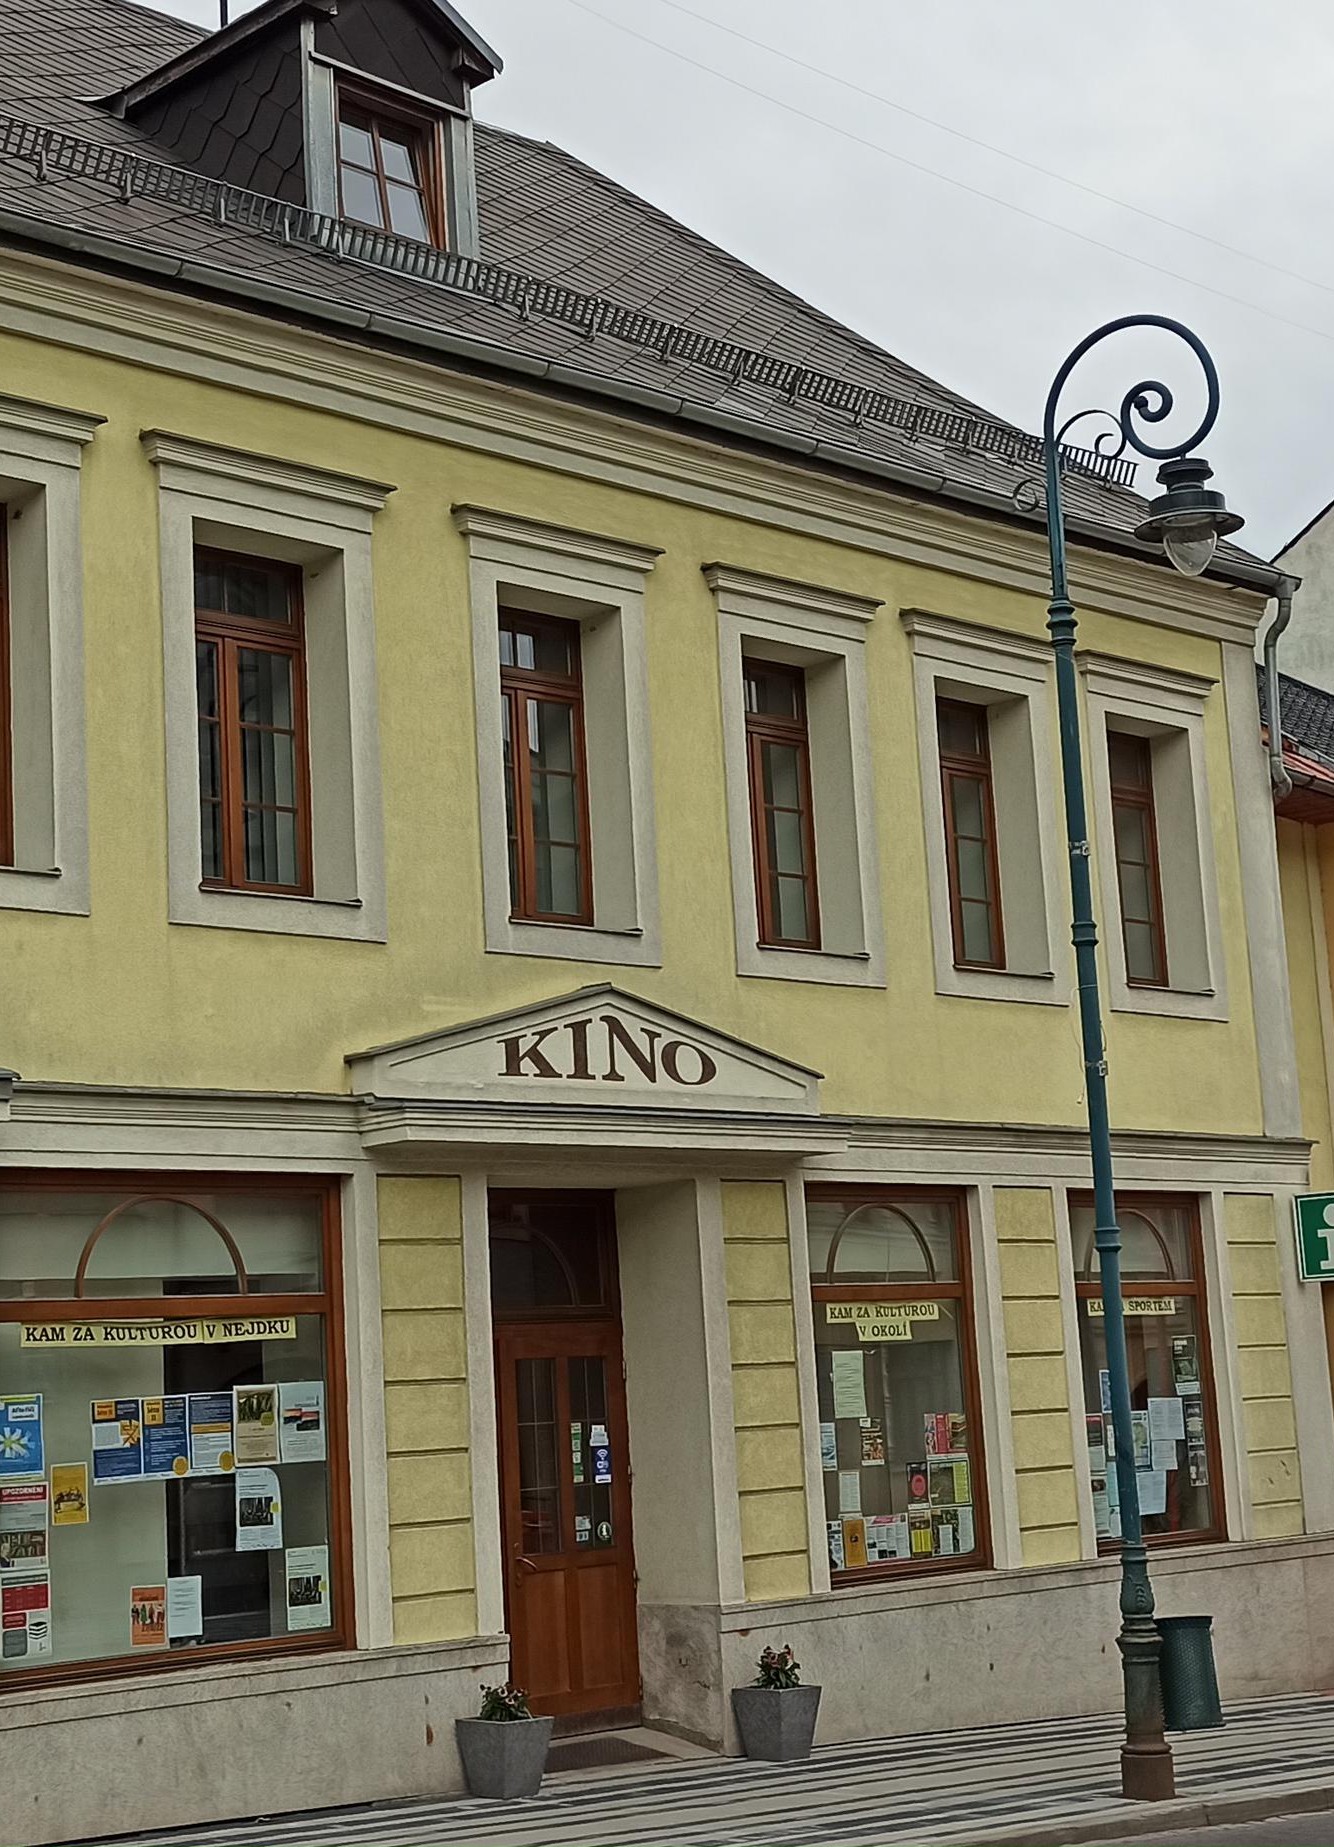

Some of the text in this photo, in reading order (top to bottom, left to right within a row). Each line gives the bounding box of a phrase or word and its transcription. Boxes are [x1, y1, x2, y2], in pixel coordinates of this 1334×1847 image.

[496, 1015, 717, 1085] KINO
[829, 1304, 935, 1319] KAM ZA KULTUROU
[1128, 1300, 1173, 1312] SPORTEM
[25, 1320, 291, 1342] KAM ZA KULTUROU V NEJDKU
[859, 1321, 908, 1337] V OKOLÍ
